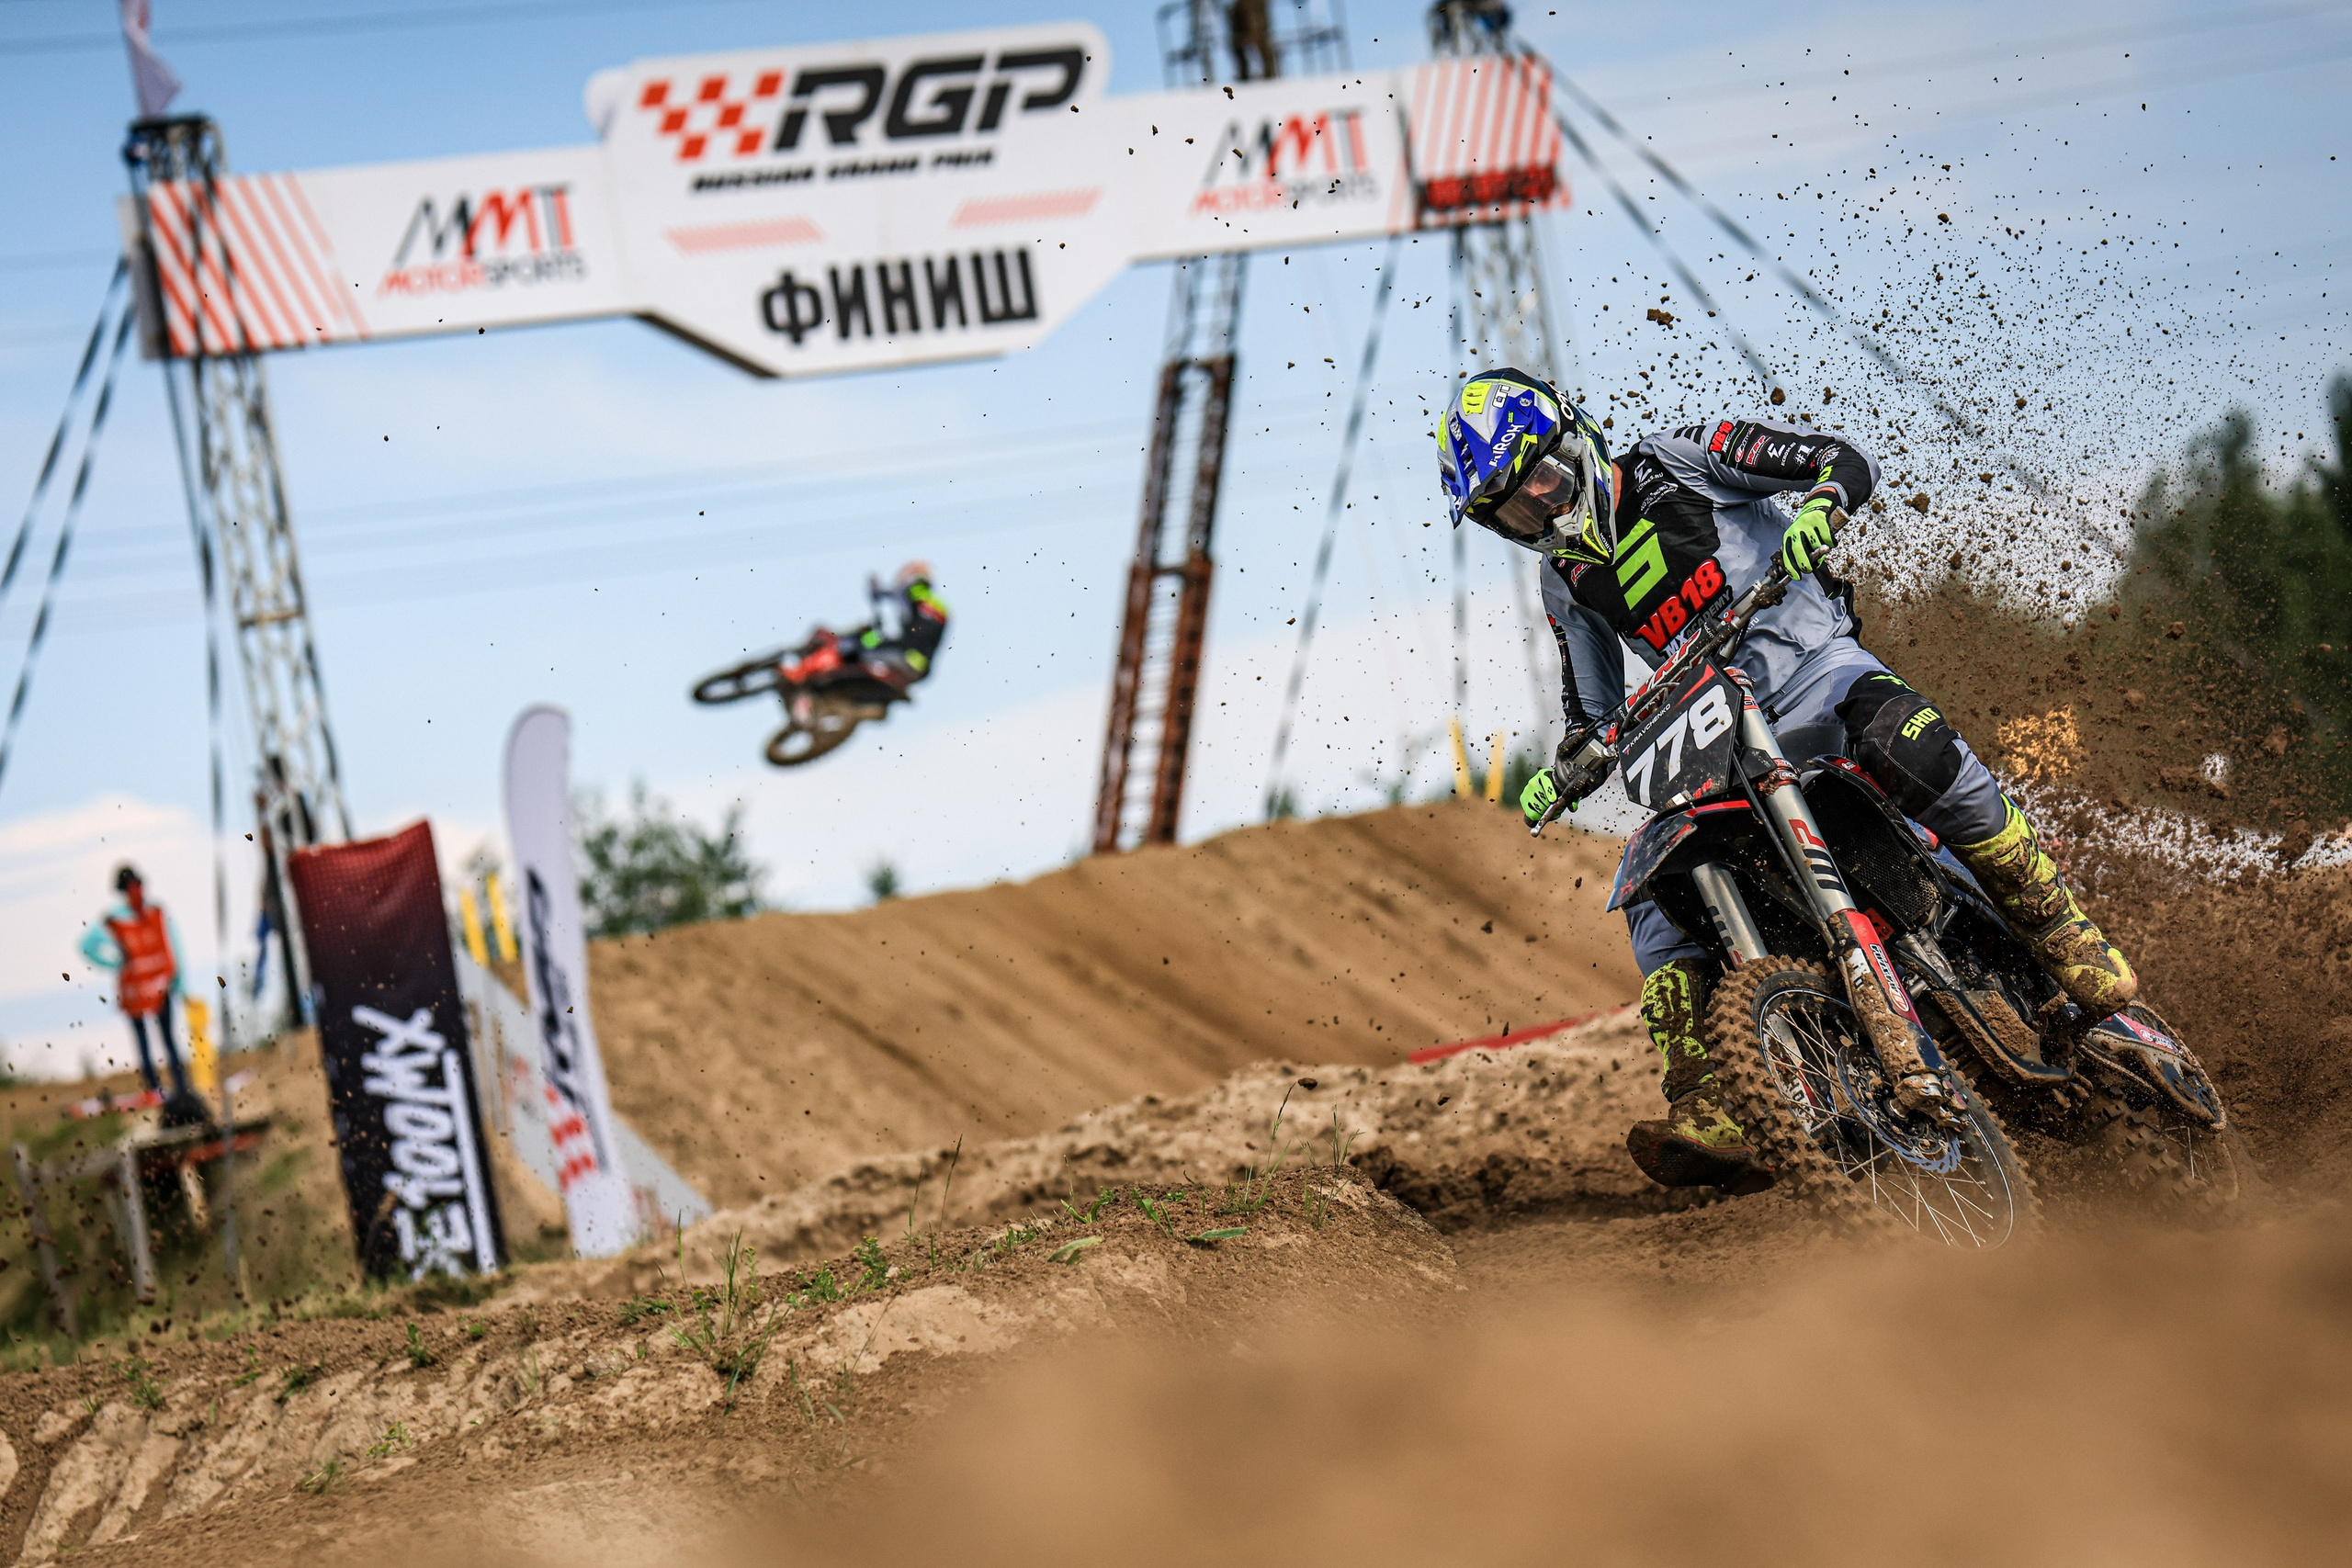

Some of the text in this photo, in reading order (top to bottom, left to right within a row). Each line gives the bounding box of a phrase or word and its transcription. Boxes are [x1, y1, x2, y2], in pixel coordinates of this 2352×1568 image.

[773, 44, 1085, 152] RGP
[1202, 107, 1365, 186] MMT
[392, 183, 574, 267] MMT
[759, 248, 1041, 345] ФИНИШ
[1489, 423, 1525, 468] AIROH
[1709, 421, 1734, 454] VB18
[1626, 684, 1734, 807] 778
[1629, 703, 1671, 747] KRAVCHENKO
[1901, 707, 1940, 741] SHOT
